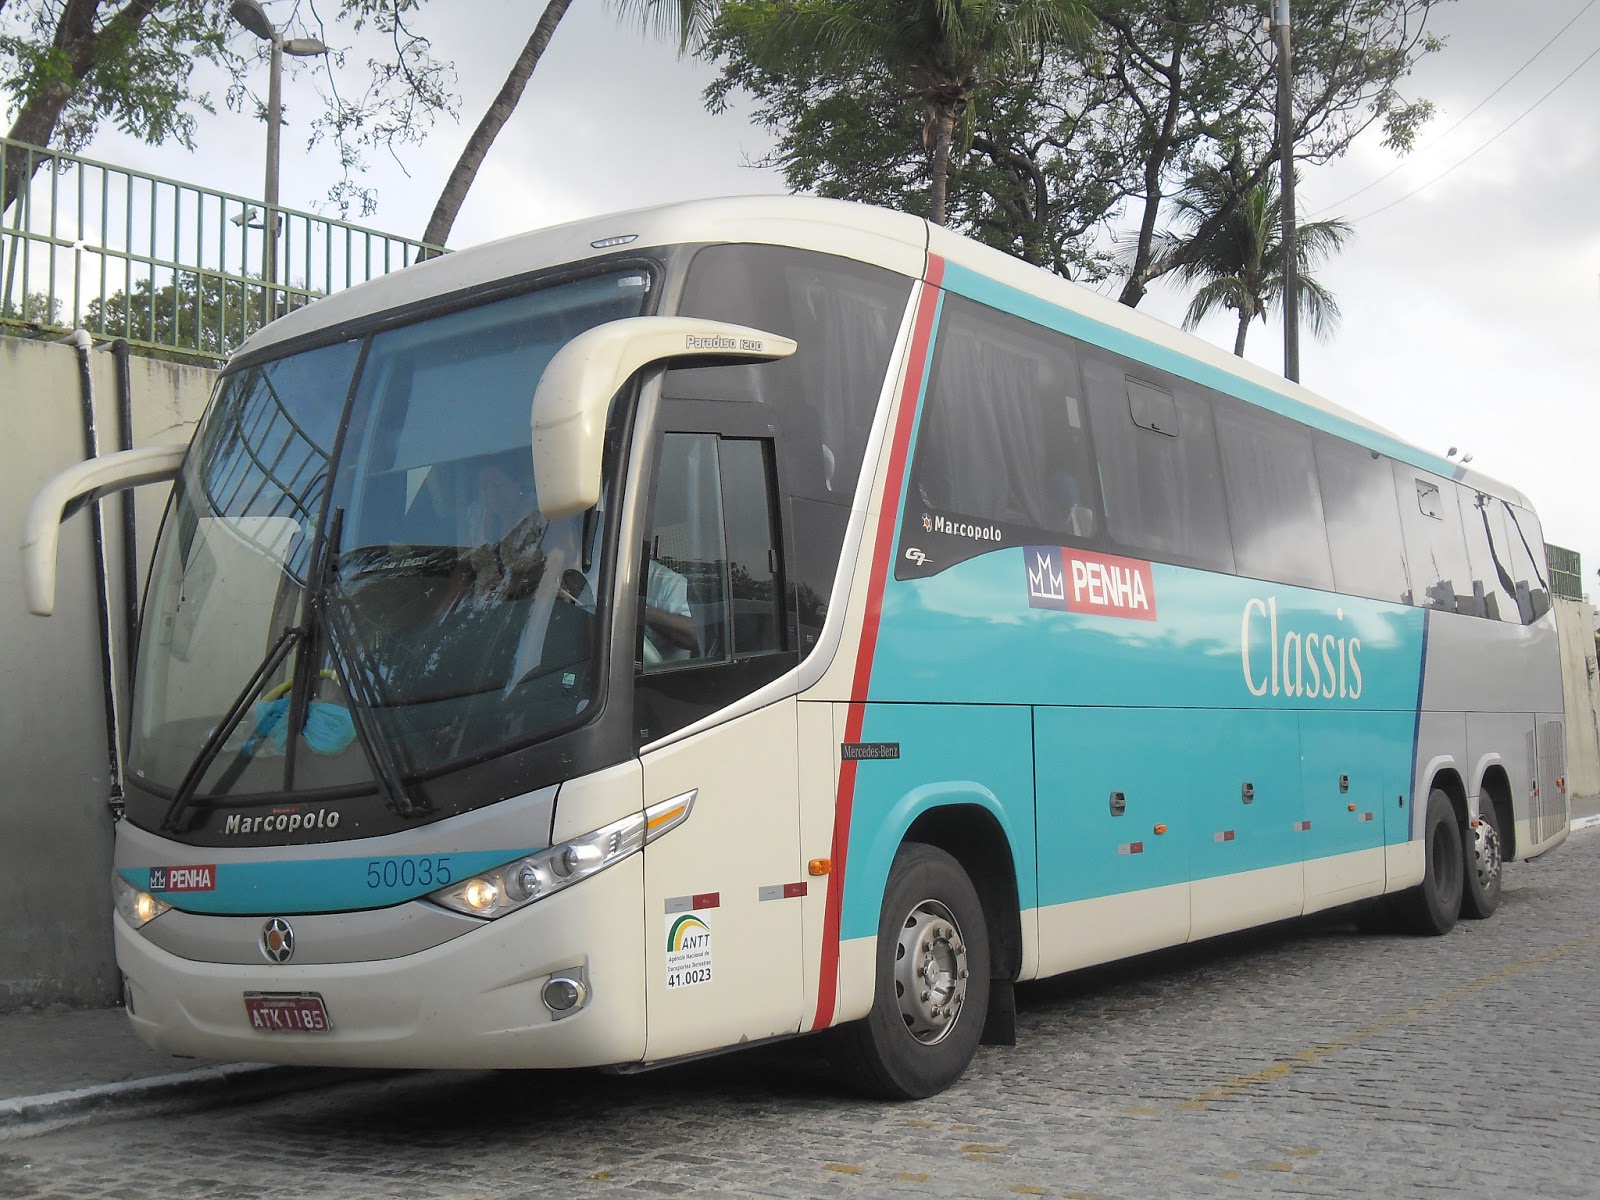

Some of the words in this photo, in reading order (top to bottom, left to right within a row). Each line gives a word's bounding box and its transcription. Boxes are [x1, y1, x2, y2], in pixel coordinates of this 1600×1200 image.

[686, 335, 736, 349] Paradiso
[740, 339, 763, 351] 1200
[934, 515, 1002, 541] Marcopolo
[1071, 559, 1149, 610] PENHA
[1241, 595, 1362, 699] Classis
[844, 745, 898, 758] Mercedes-Benz
[225, 808, 340, 834] Marcopolo
[169, 869, 211, 888] PENHA
[367, 857, 451, 889] 50035
[682, 934, 710, 950] ANTT
[668, 968, 711, 988] 41.0023
